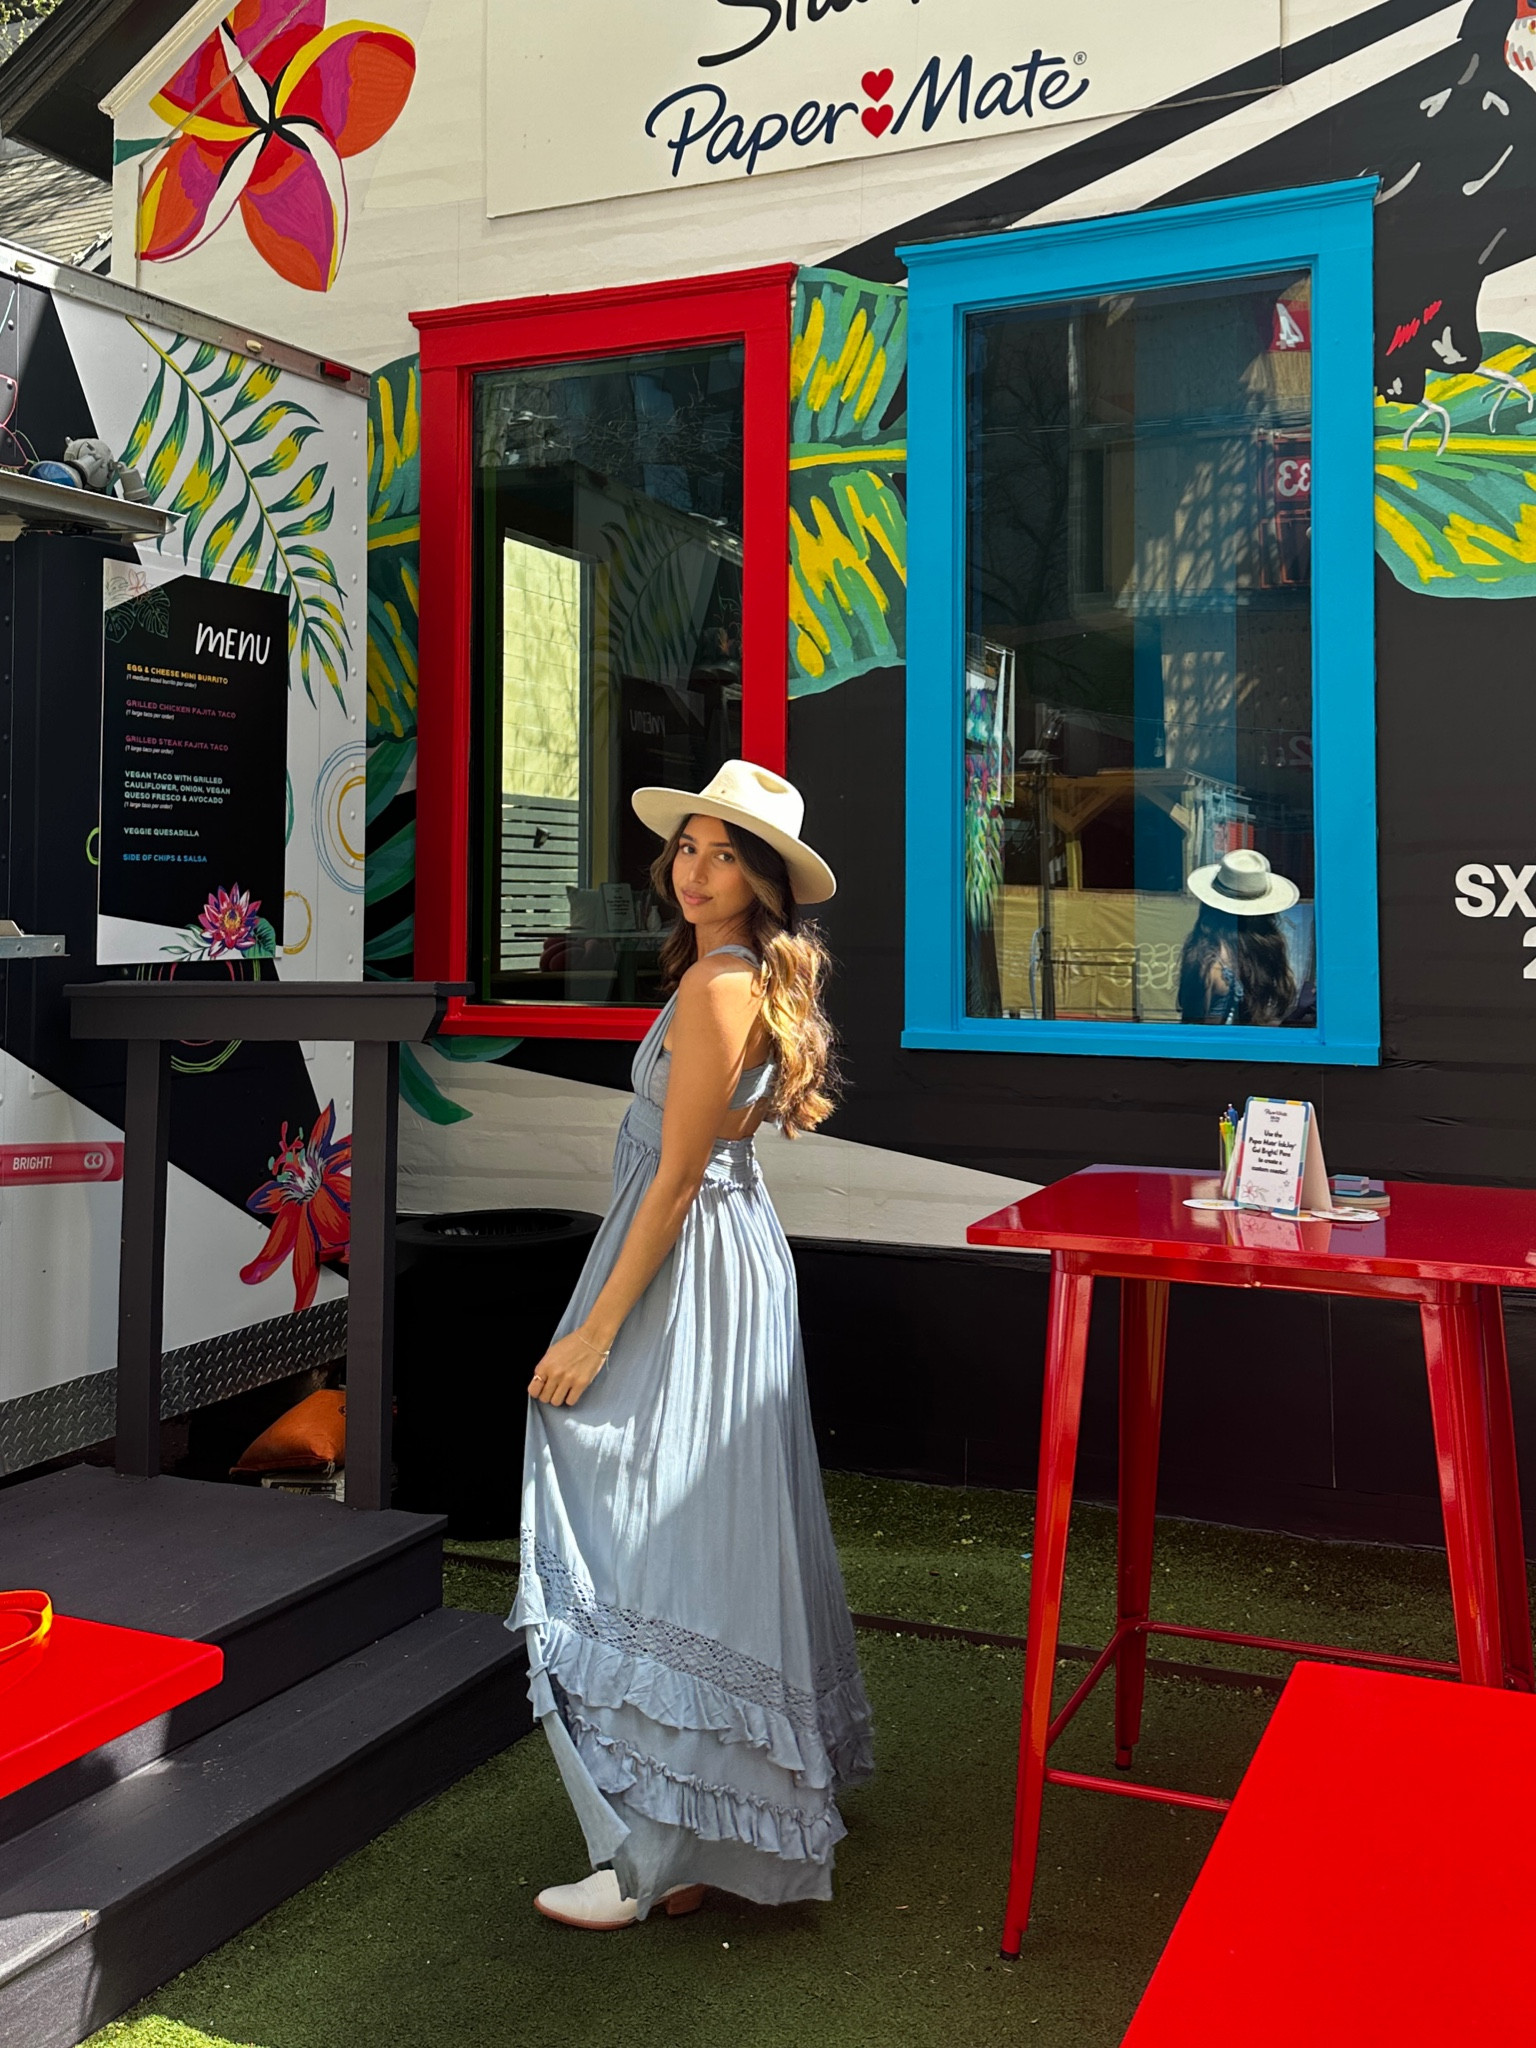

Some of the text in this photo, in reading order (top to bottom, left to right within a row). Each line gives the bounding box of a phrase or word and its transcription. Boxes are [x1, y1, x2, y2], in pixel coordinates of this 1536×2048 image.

[645, 83, 860, 177] Paper
[195, 622, 271, 665] MENU
[126, 664, 228, 685] EGG & CHEESE MINI BURRITO
[126, 699, 237, 719] GRILLED CHICKEN FAJITA TACO
[125, 735, 229, 752] GRILLED STEAK FAJITA TACO
[125, 770, 223, 784] VEGAN TACO WITH GRILLED
[124, 781, 231, 795] CAULIFLOWER, ONION, VEGAN
[124, 791, 150, 800] QUESO
[151, 793, 181, 802] FRESCO
[188, 795, 224, 804] AVOCADO
[123, 827, 200, 837] VEGGIE QUESADILLA
[123, 853, 141, 861] SIDE
[153, 854, 176, 862] CHIPS
[183, 855, 208, 863] SALSA
[13, 1156, 53, 1170] BRIGHT!
